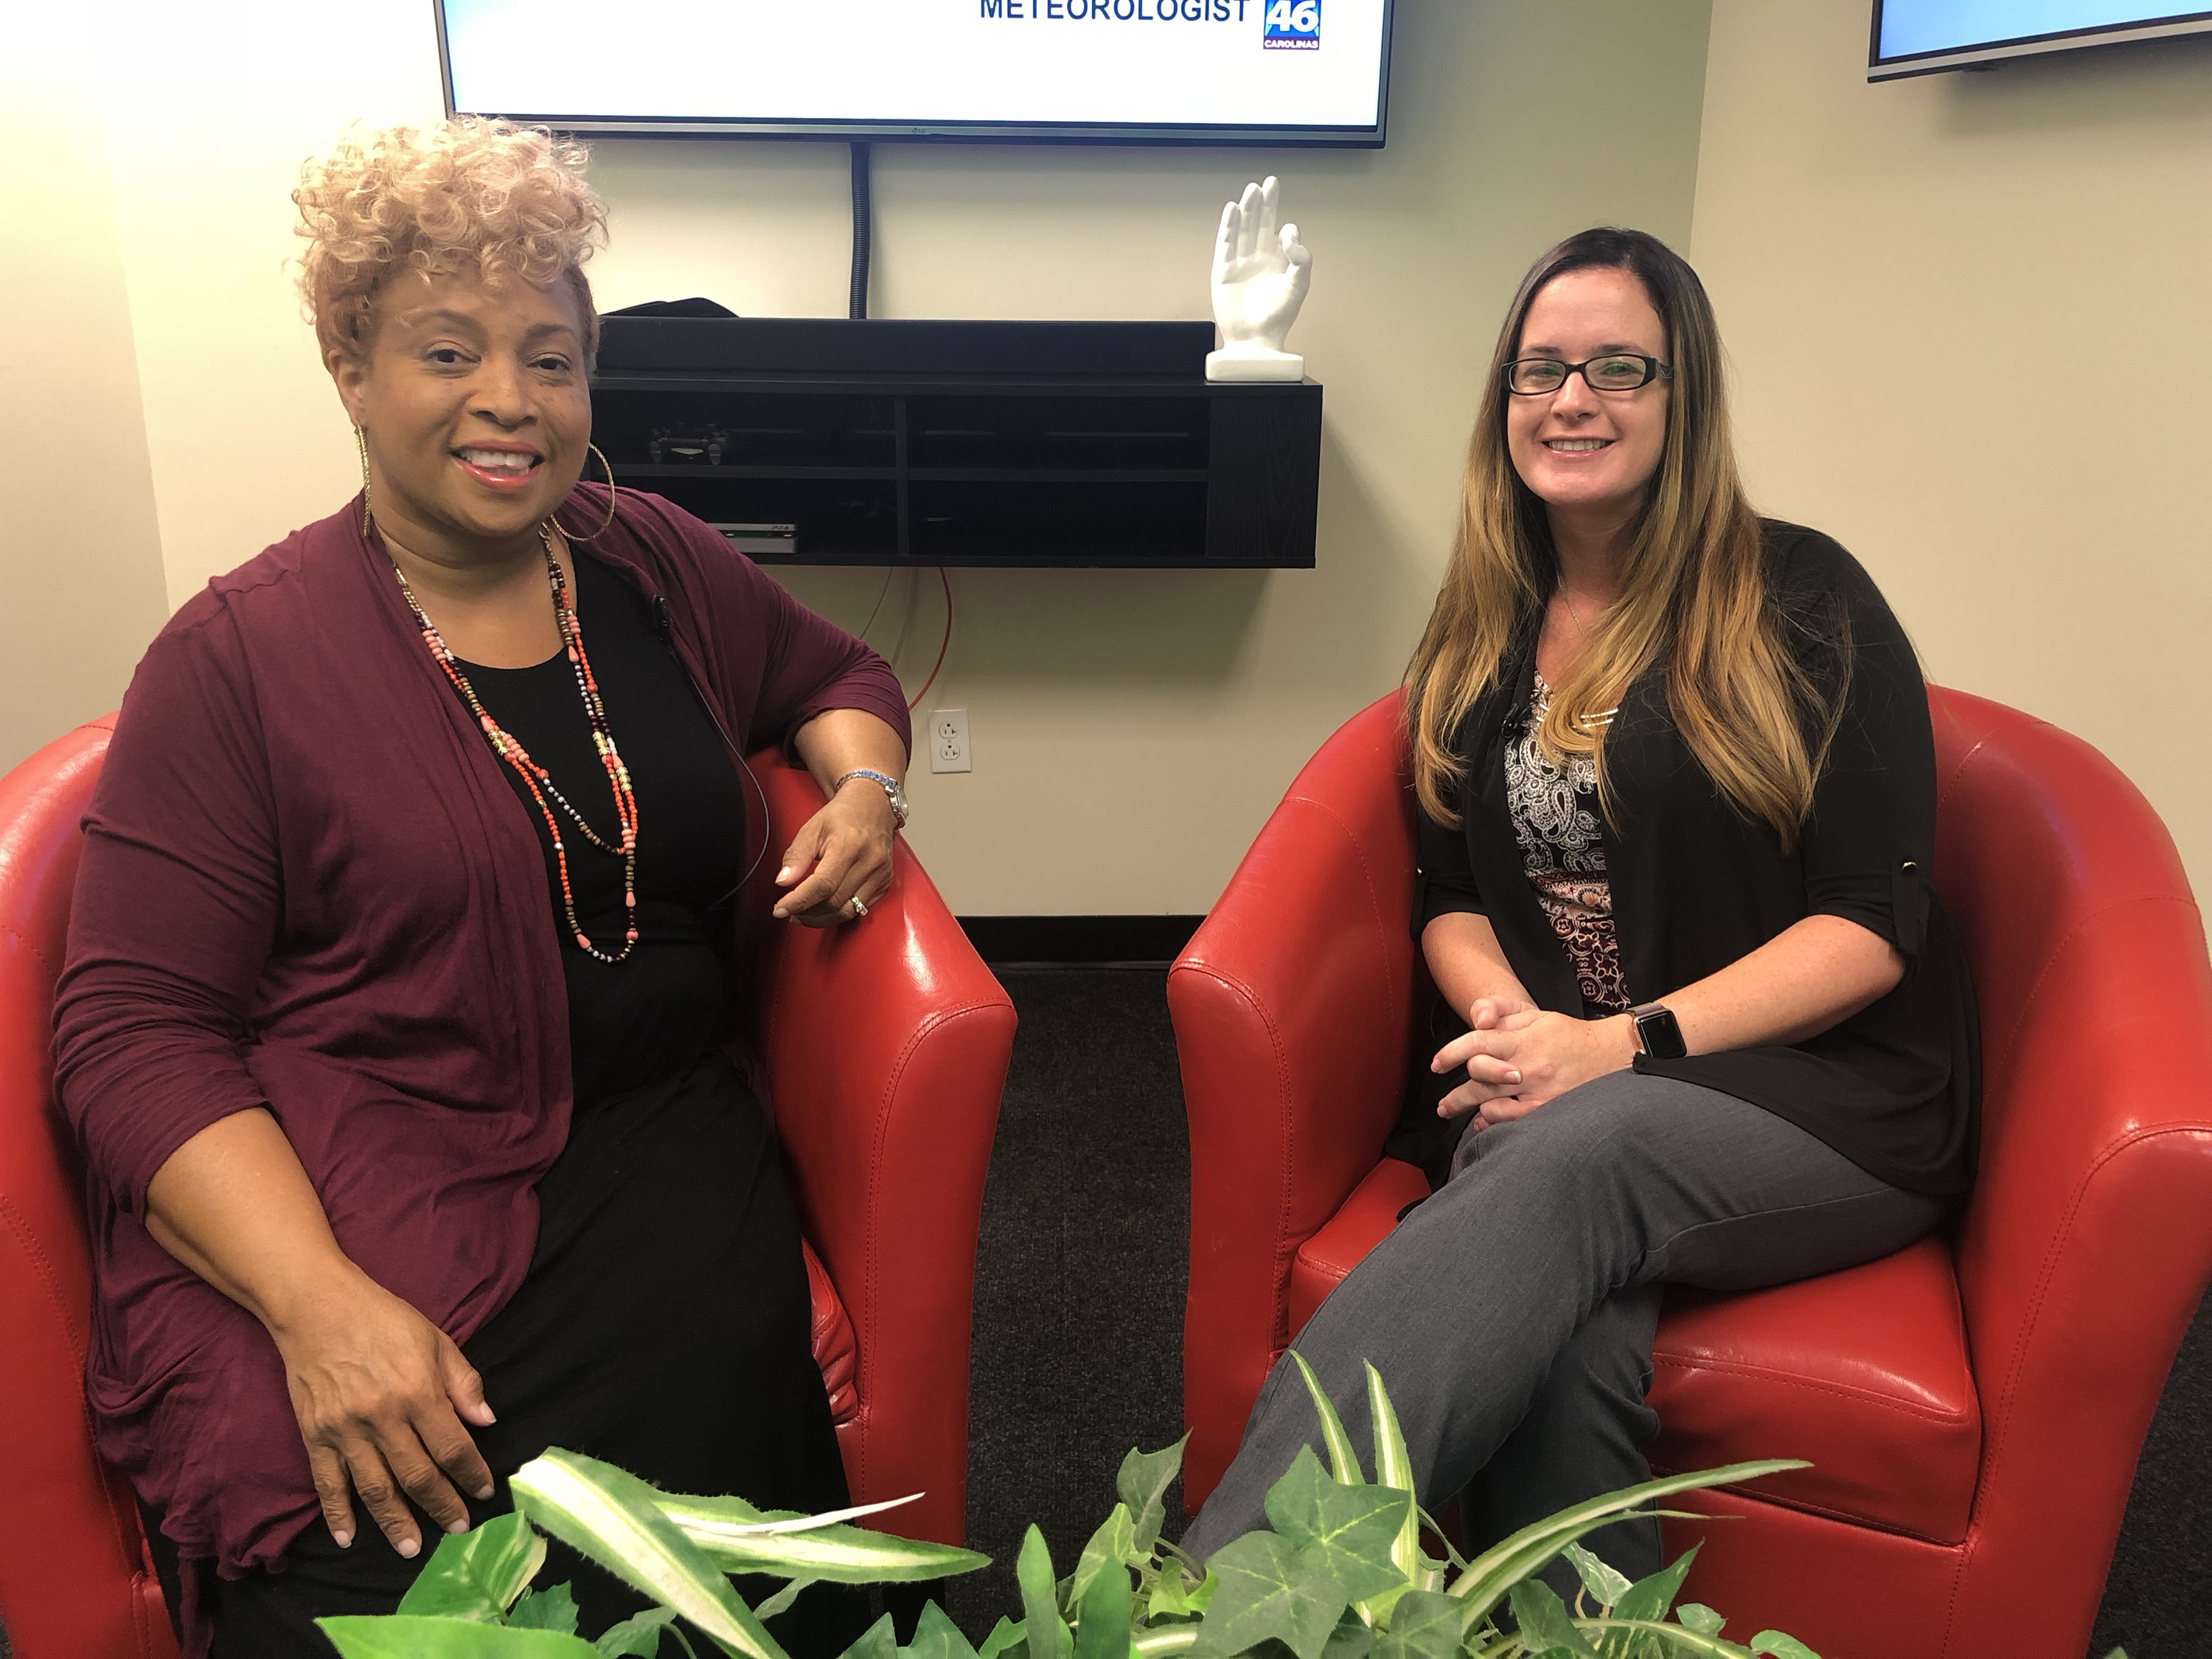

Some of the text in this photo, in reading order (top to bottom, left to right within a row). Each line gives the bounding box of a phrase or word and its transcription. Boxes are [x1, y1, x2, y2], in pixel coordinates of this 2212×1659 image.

[981, 0, 1251, 21] METEOROLOGIST
[1266, 0, 1319, 32] 46
[1264, 39, 1318, 49] CAROLINAS
